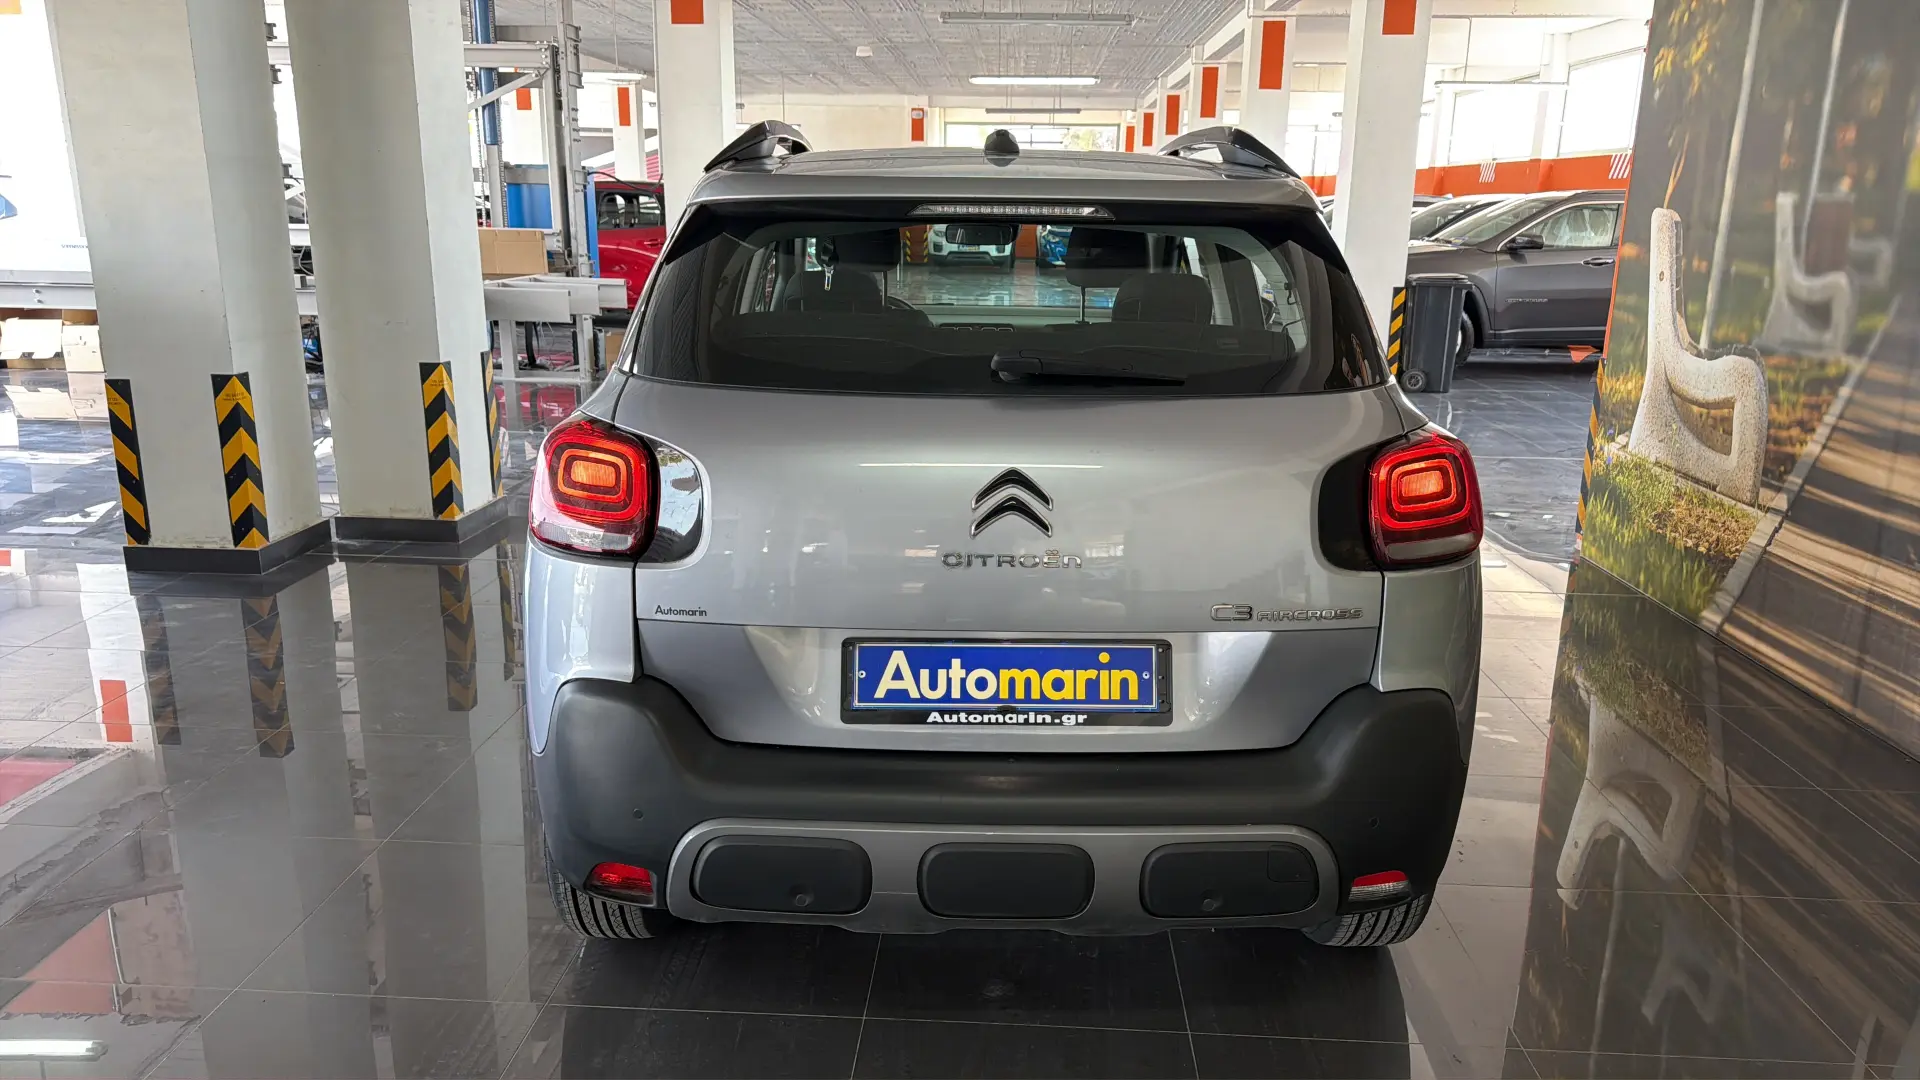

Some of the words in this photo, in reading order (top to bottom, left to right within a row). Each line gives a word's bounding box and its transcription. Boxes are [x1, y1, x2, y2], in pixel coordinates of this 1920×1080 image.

[655, 604, 707, 616] Automarin
[1211, 603, 1252, 621] C3
[1257, 607, 1363, 621] AIRCROSS
[873, 650, 1139, 700] Automarin
[926, 711, 1088, 725] Automarin.gr
